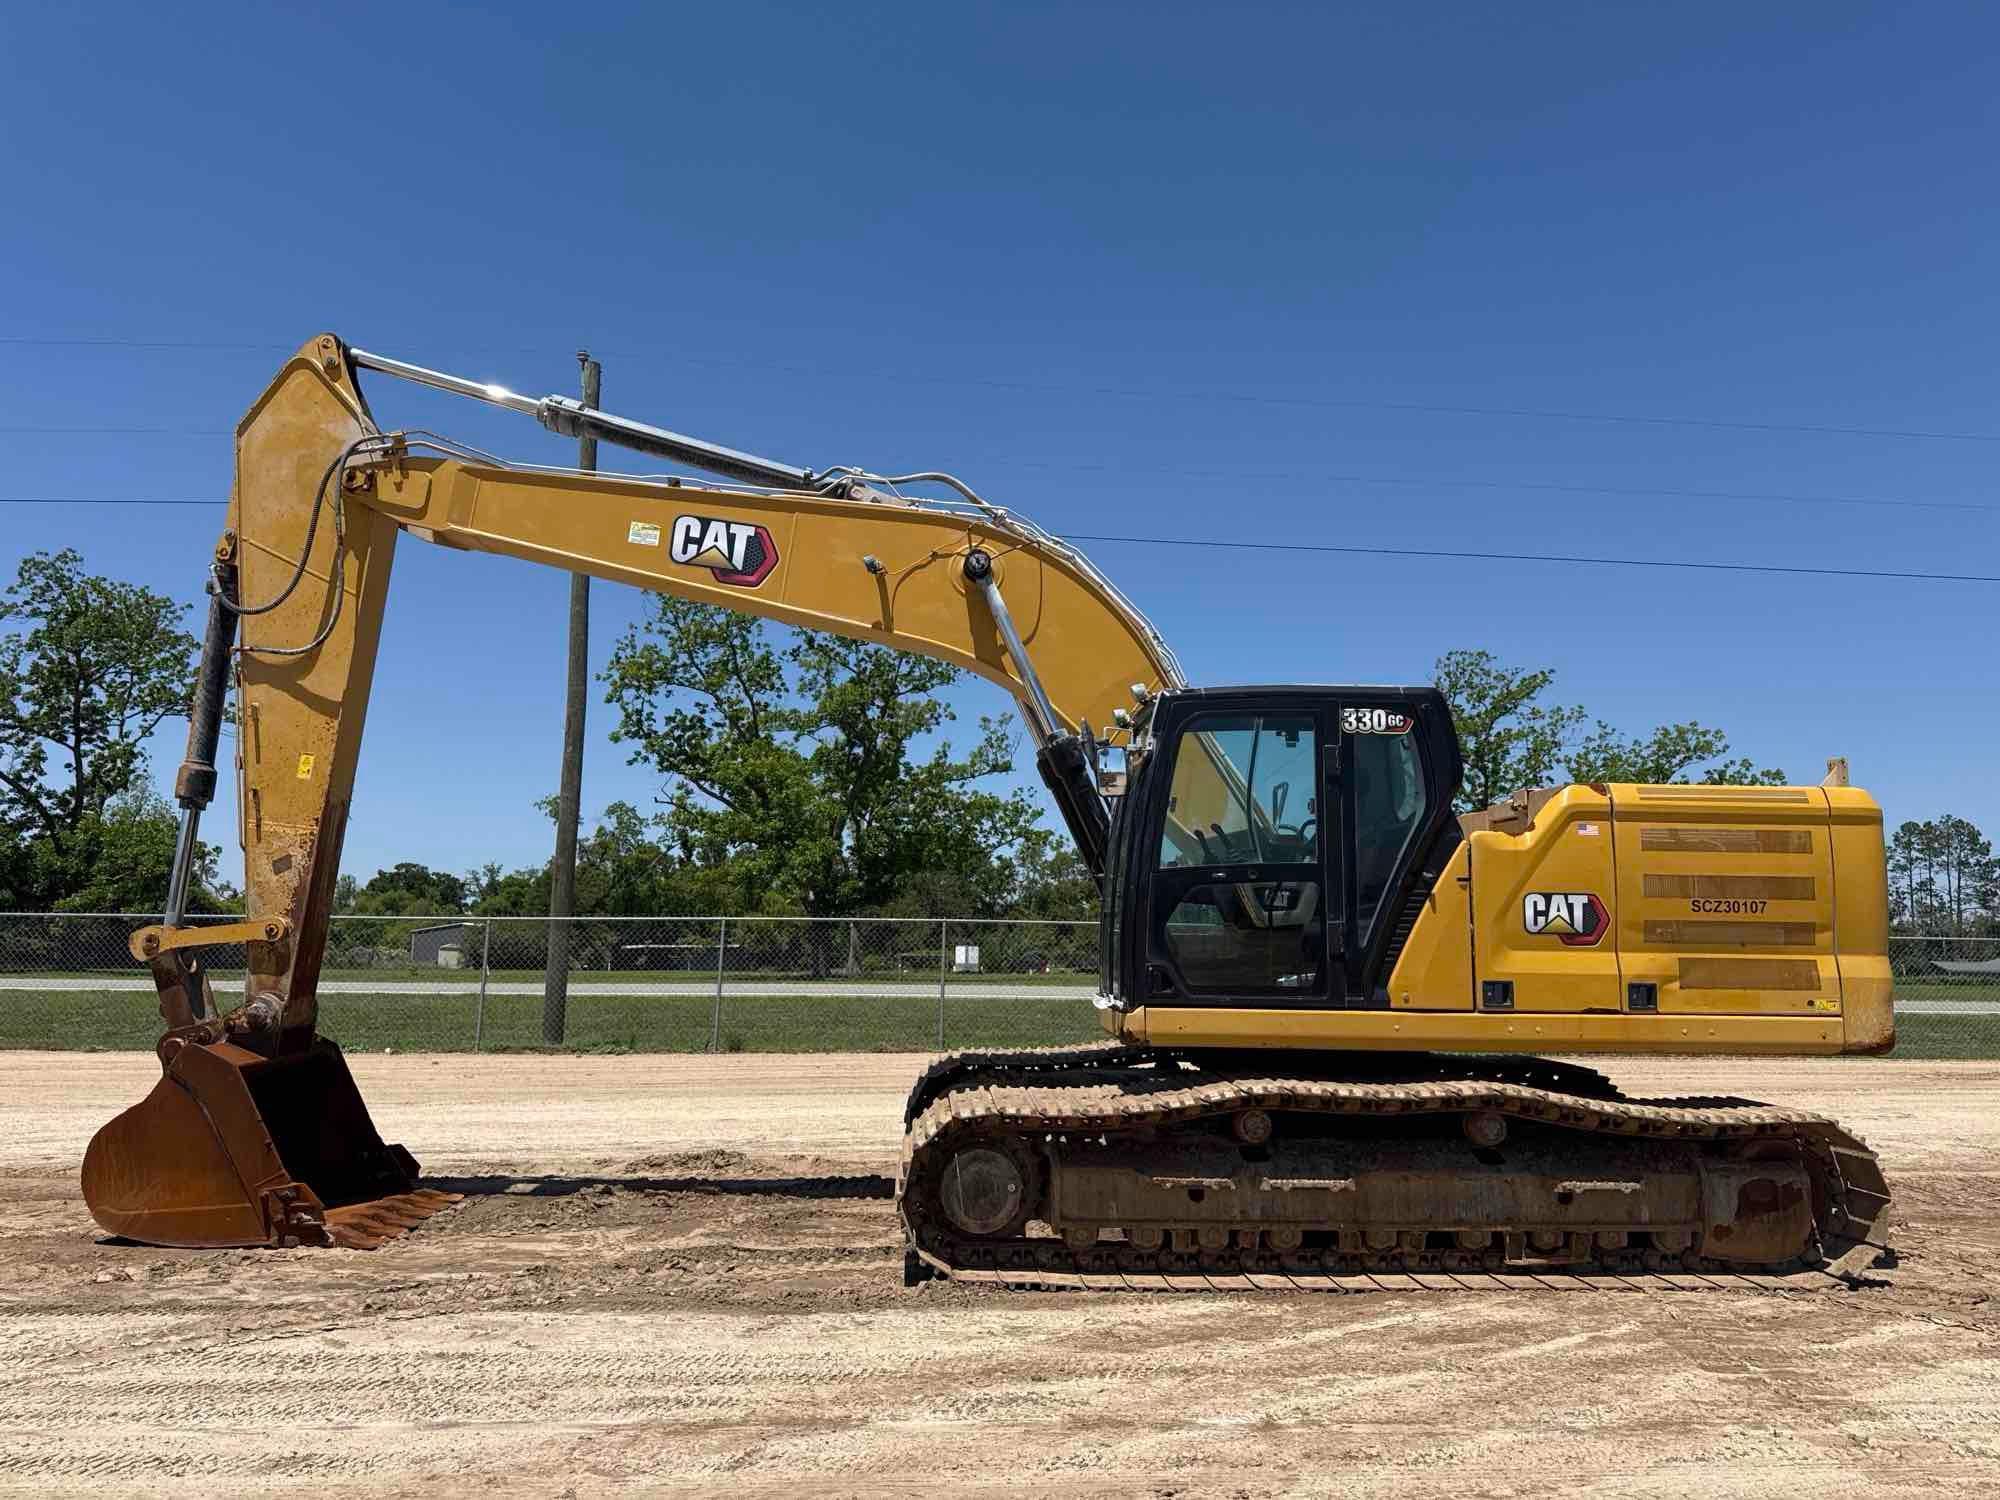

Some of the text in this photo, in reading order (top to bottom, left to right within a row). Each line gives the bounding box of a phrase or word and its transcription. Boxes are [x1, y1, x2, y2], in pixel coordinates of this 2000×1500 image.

[671, 515, 756, 571] CAT
[1343, 708, 1404, 731] 330 GC
[1524, 893, 1589, 933] CAT
[1691, 899, 1768, 913] SCZ30107
